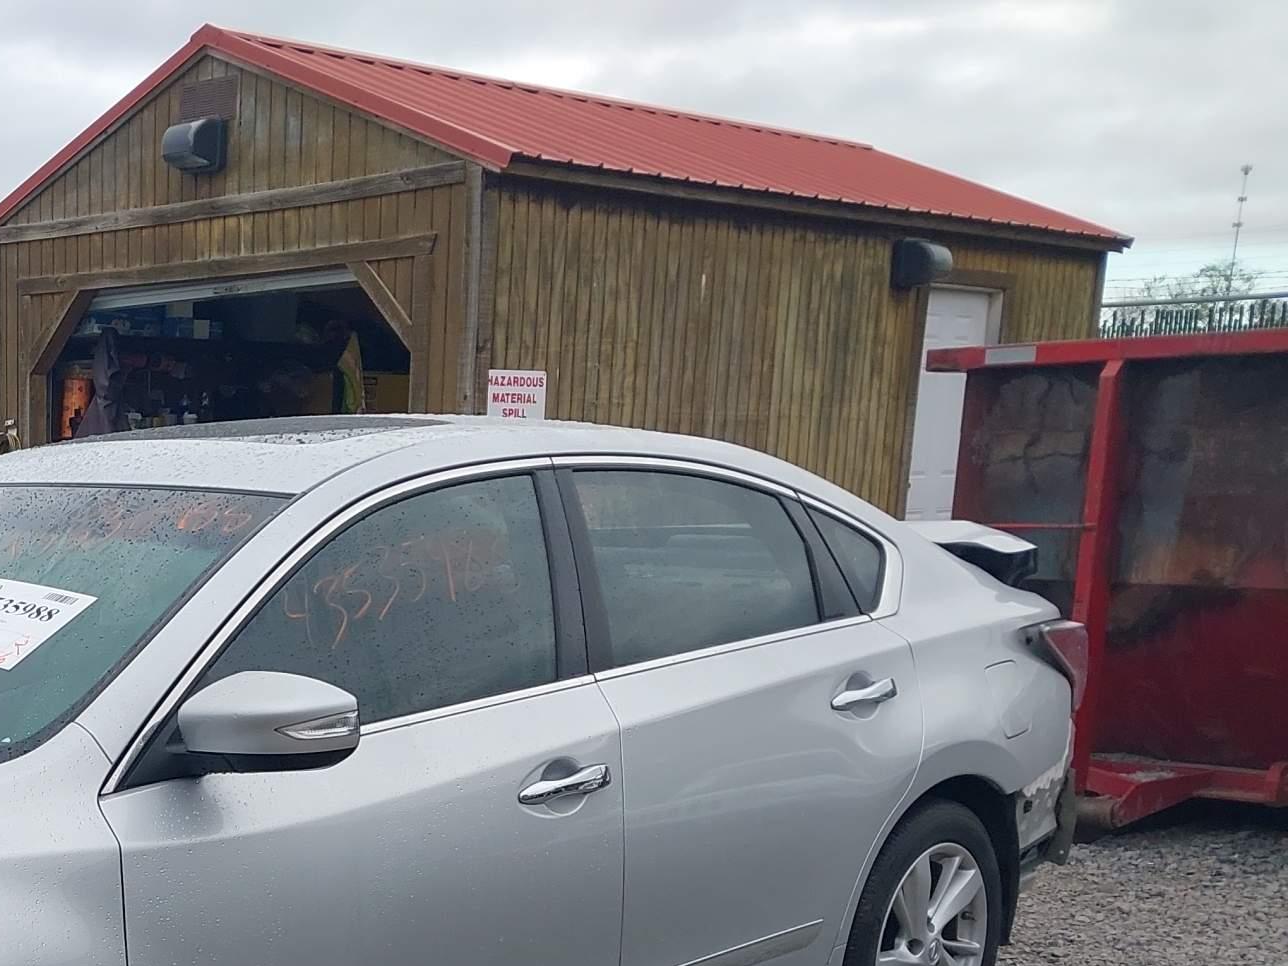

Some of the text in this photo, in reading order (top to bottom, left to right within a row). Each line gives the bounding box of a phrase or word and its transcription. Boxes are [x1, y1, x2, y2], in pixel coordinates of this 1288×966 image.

[488, 375, 544, 387] HAZARDOUS
[492, 392, 537, 404] MATERIAL
[502, 408, 527, 419] SPILL
